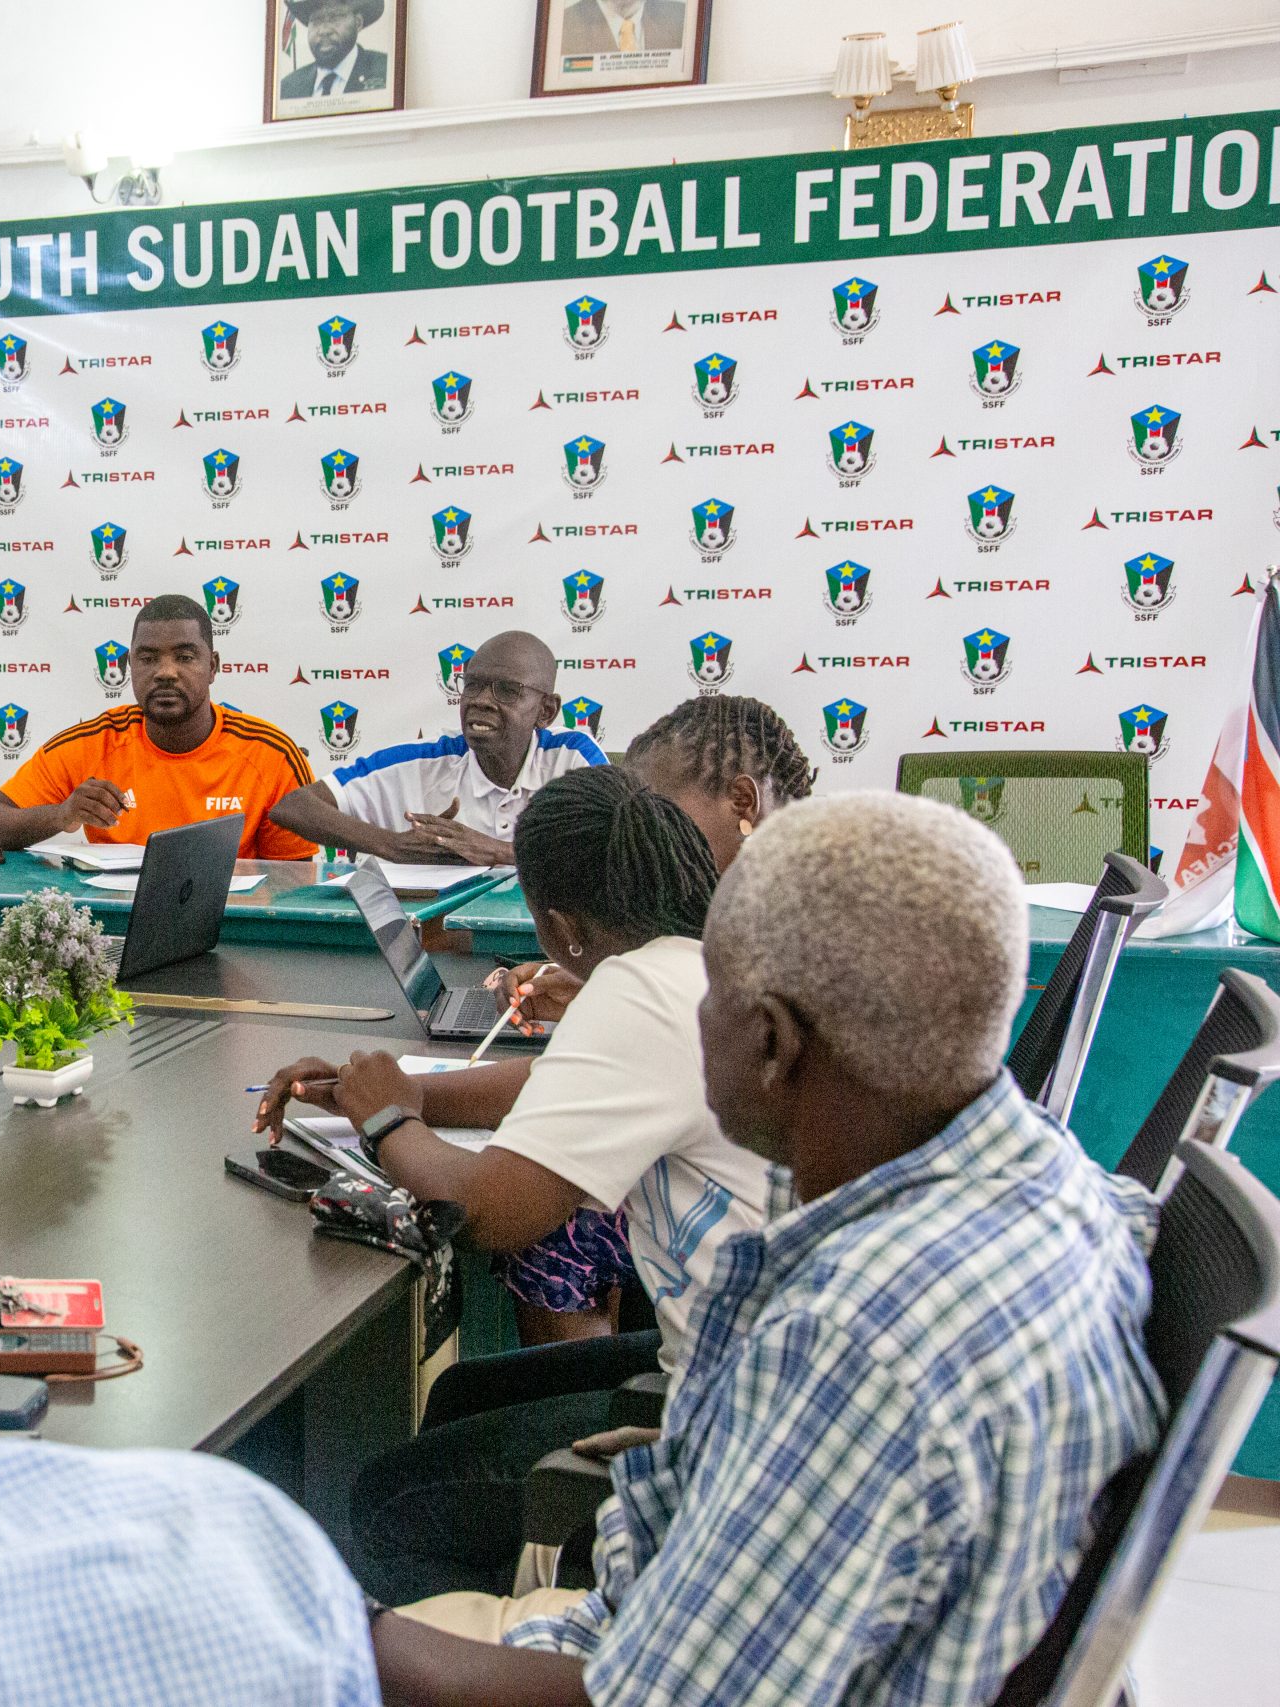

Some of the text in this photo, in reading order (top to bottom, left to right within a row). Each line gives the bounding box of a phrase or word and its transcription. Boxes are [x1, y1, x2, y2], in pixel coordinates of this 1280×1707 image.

[127, 208, 359, 292] SUDAN
[391, 177, 761, 273] FOOTBALL
[794, 127, 1280, 244] FEDERATIO
[962, 290, 1061, 308] TRISTAR
[687, 309, 778, 325] TRISTAR
[1147, 317, 1173, 328] SSFF
[427, 323, 510, 339] TRISTAR
[842, 336, 865, 346] SSFF
[574, 352, 596, 361] SSFF
[1116, 351, 1221, 369] TRISTAR
[77, 355, 152, 369] TRISTAR
[210, 373, 229, 382] SSFF
[326, 370, 347, 379] SSFF
[2, 384, 20, 394] SSFF
[820, 377, 914, 393] TRISTAR
[553, 389, 640, 404] TRISTAR
[307, 402, 387, 417] TRISTAR
[981, 400, 1006, 409] SSFF
[192, 408, 270, 423] TRISTAR
[703, 410, 725, 419] SSFF
[441, 426, 462, 435] SSFF
[957, 436, 1056, 451] TRISTAR
[100, 449, 118, 458] SSFF
[685, 443, 775, 457] TRISTAR
[431, 463, 514, 478] TRISTAR
[1140, 466, 1165, 476] SSFF
[81, 471, 155, 483] TRISTAR
[838, 479, 861, 489] SSFF
[572, 491, 594, 500] SSFF
[211, 501, 231, 510] SSFF
[330, 503, 350, 512] SSFF
[0, 508, 16, 516] SSFF
[1110, 508, 1213, 524] TRISTAR
[551, 524, 638, 537] TRISTAR
[821, 518, 914, 533] TRISTAR
[309, 532, 389, 545] TRISTAR
[194, 538, 271, 551] TRISTAR
[977, 544, 1001, 554] SSFF
[441, 560, 461, 569] SSFF
[701, 555, 723, 564] SSFF
[100, 573, 118, 582] SSFF
[953, 579, 1050, 593] TRISTAR
[683, 588, 772, 600] TRISTAR
[431, 596, 514, 609] TRISTAR
[1134, 612, 1159, 622] SSFF
[835, 618, 858, 627] SSFF
[1, 629, 19, 637] SSFF
[330, 625, 350, 634] SSFF
[571, 625, 593, 633] SSFF
[817, 656, 910, 668] TRISTAR
[1104, 655, 1207, 669] TRISTAR
[221, 663, 269, 674] STAR
[310, 669, 390, 680] TRISTAR
[104, 691, 122, 699] SSFF
[698, 688, 720, 696] SSFF
[972, 686, 996, 696] SSFF
[948, 720, 1045, 733] TRISTAR
[3, 753, 20, 761] SSFF
[329, 753, 348, 762] SSFF
[831, 755, 855, 764] SSFF
[205, 796, 243, 811] FIFA
